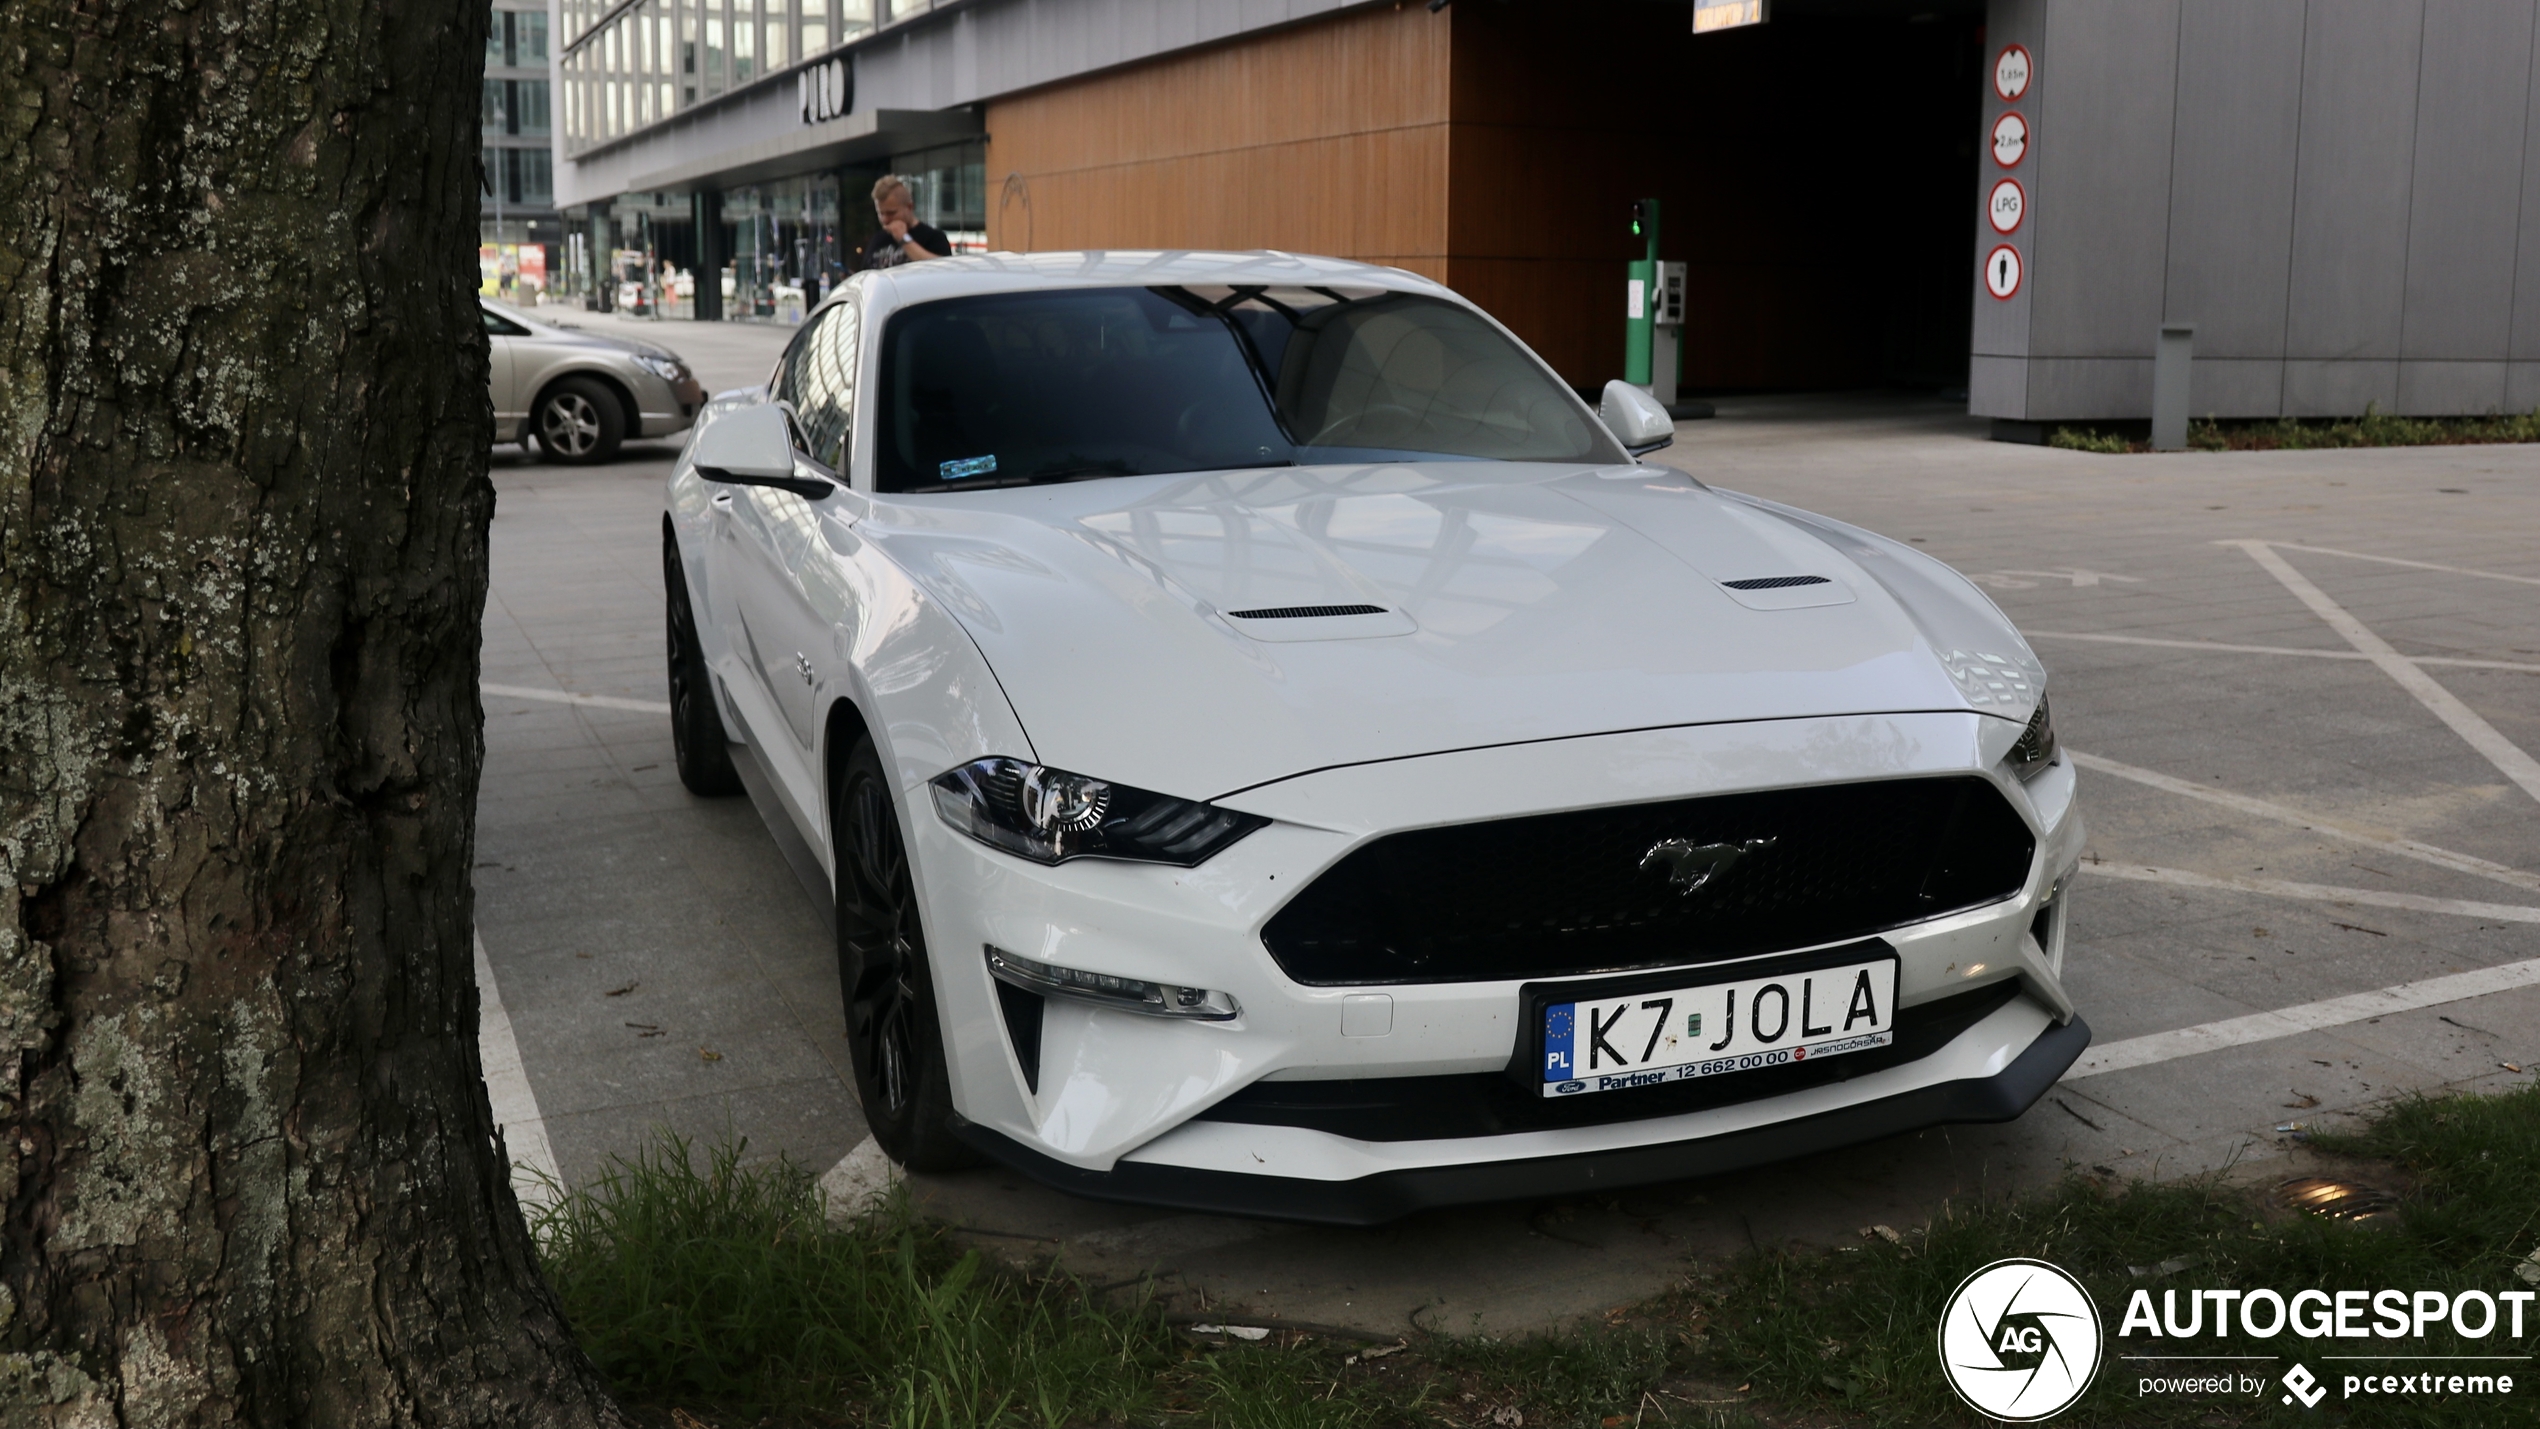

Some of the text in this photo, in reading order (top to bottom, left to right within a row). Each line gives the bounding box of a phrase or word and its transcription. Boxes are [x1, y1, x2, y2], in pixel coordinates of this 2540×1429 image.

[798, 57, 845, 123] PURO
[1996, 197, 2018, 212] LPG
[1589, 969, 1878, 1070] K7 JOLA
[1547, 1052, 1570, 1070] PL
[1599, 1071, 1666, 1090] Partner
[1677, 1067, 1695, 1079] 12
[1701, 1059, 1735, 1075] 662
[1740, 1055, 1762, 1069] 00
[1766, 1051, 1788, 1065] 00
[1561, 1081, 1580, 1093] Ford
